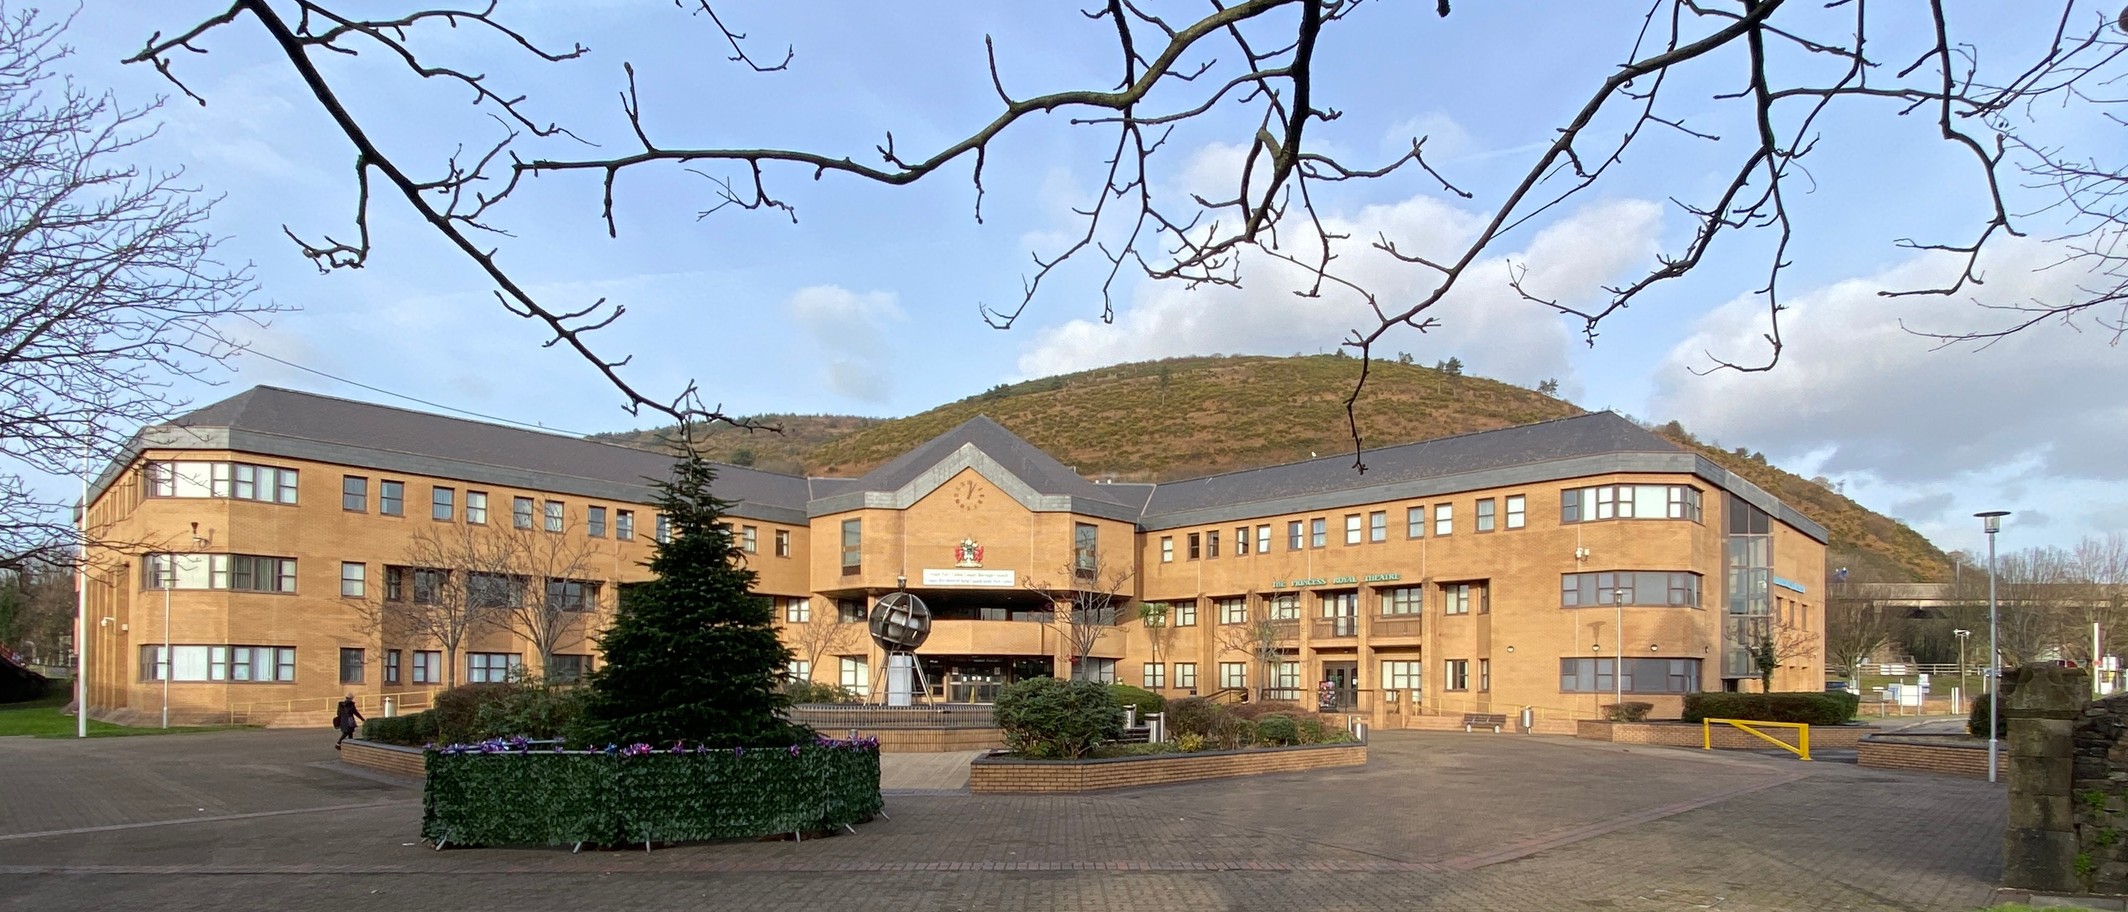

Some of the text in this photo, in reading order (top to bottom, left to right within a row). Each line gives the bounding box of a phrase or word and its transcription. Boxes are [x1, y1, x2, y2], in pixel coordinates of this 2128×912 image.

[1291, 579, 1327, 587] PRINCESS
[1333, 576, 1357, 584] ROYAL
[1365, 573, 1400, 582] THEATRE
